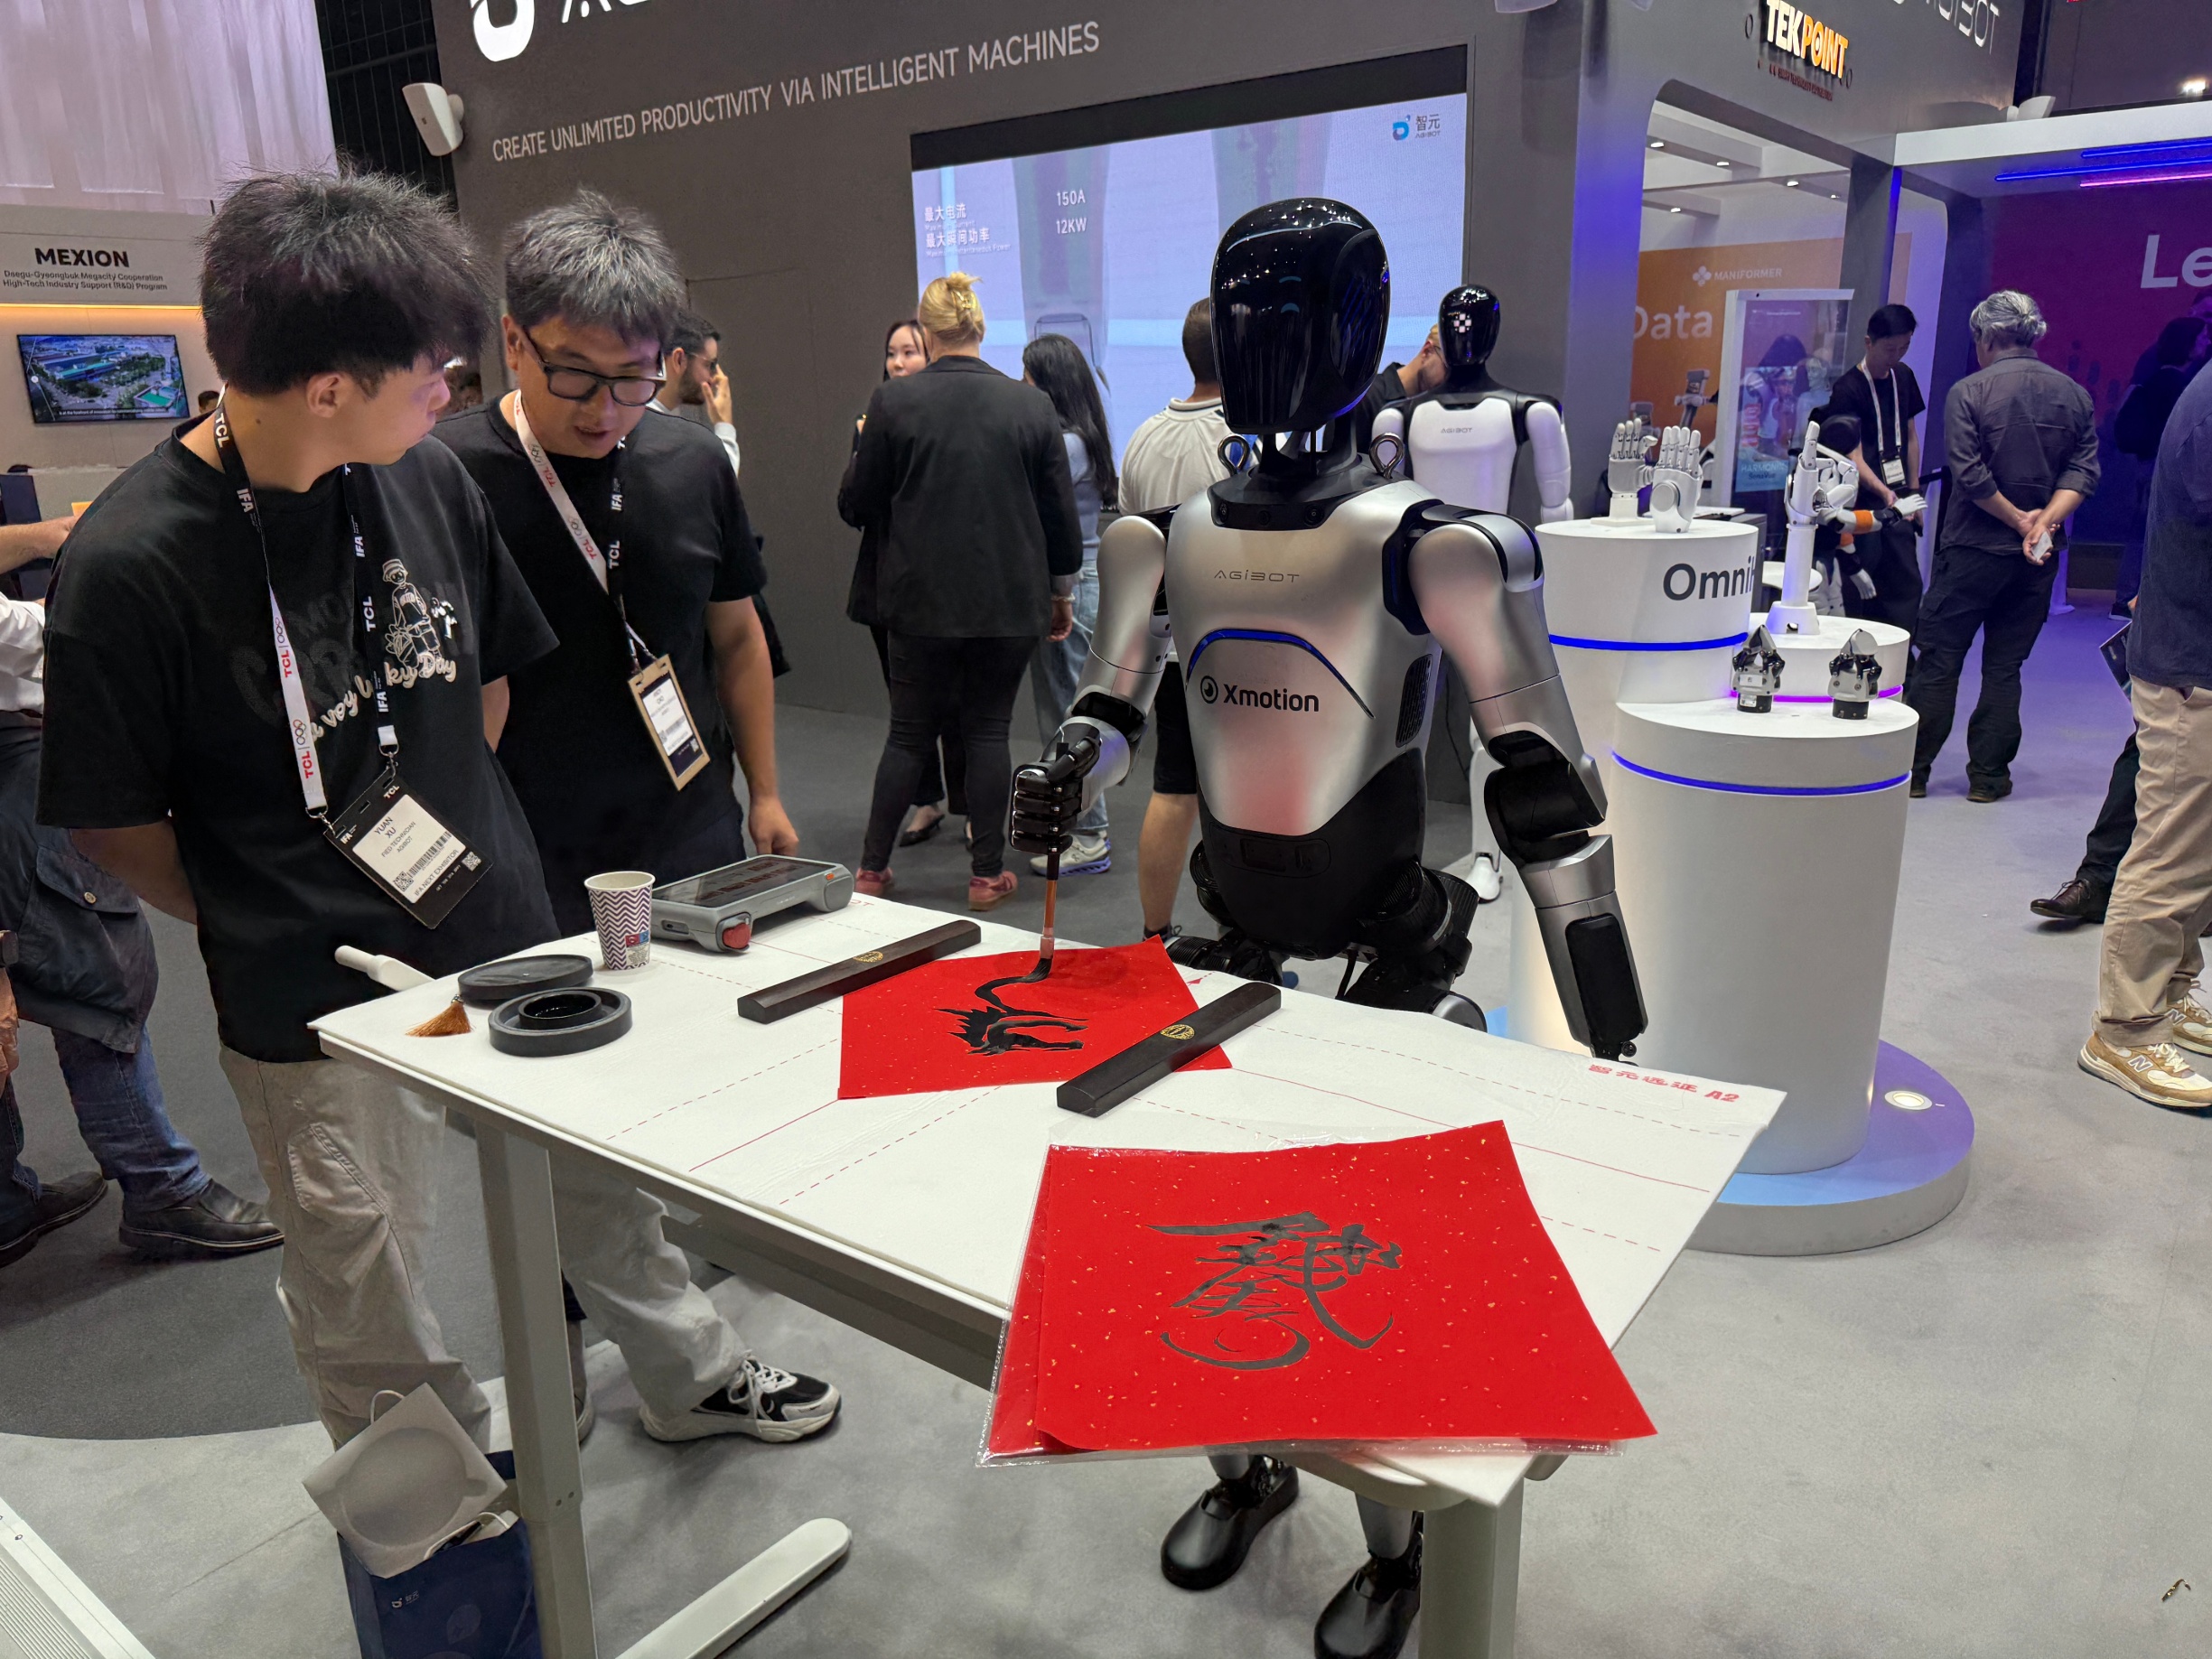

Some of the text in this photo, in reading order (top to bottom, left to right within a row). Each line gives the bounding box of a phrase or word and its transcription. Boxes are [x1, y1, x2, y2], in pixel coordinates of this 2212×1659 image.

[1766, 0, 1849, 79] TEKPOINT
[492, 20, 1100, 163] CREATE UNLIMITED PRODUCTIVITY VIA INTELLIGENT MACHINES
[1415, 113, 1442, 132] 智元
[1055, 188, 1087, 207] 150A
[923, 203, 968, 223] 最大电流
[1055, 217, 1088, 235] 12KW
[34, 247, 130, 268] MEXION
[2140, 233, 2212, 289] Le
[3, 279, 45, 288] High-Tech
[46, 281, 79, 290] Industry
[80, 282, 112, 290] Support
[135, 284, 168, 292] Program
[80, 273, 117, 282] Megacity
[117, 274, 163, 283] Cooperation
[1713, 267, 1784, 282] MANIFORMER
[215, 413, 229, 448] TCL
[236, 488, 256, 514] IFA
[611, 494, 623, 512] IFA
[354, 536, 366, 559] IFA
[583, 539, 598, 561] TCL
[608, 540, 621, 571] TCL
[363, 595, 377, 633] TCL
[280, 649, 293, 678] TCL
[376, 690, 389, 713] IFA
[1223, 683, 1320, 713] Xmotion
[302, 750, 314, 779] TCL
[340, 833, 353, 844] IFA
[383, 785, 400, 799] TCL
[374, 816, 394, 836] YUAN
[384, 826, 397, 839] XU
[391, 820, 416, 850] TECHNICIAN
[414, 885, 425, 897] IFA
[422, 871, 439, 890] NEXT
[434, 848, 460, 876] EXHIBITOR
[1703, 1090, 1741, 1103] A2
